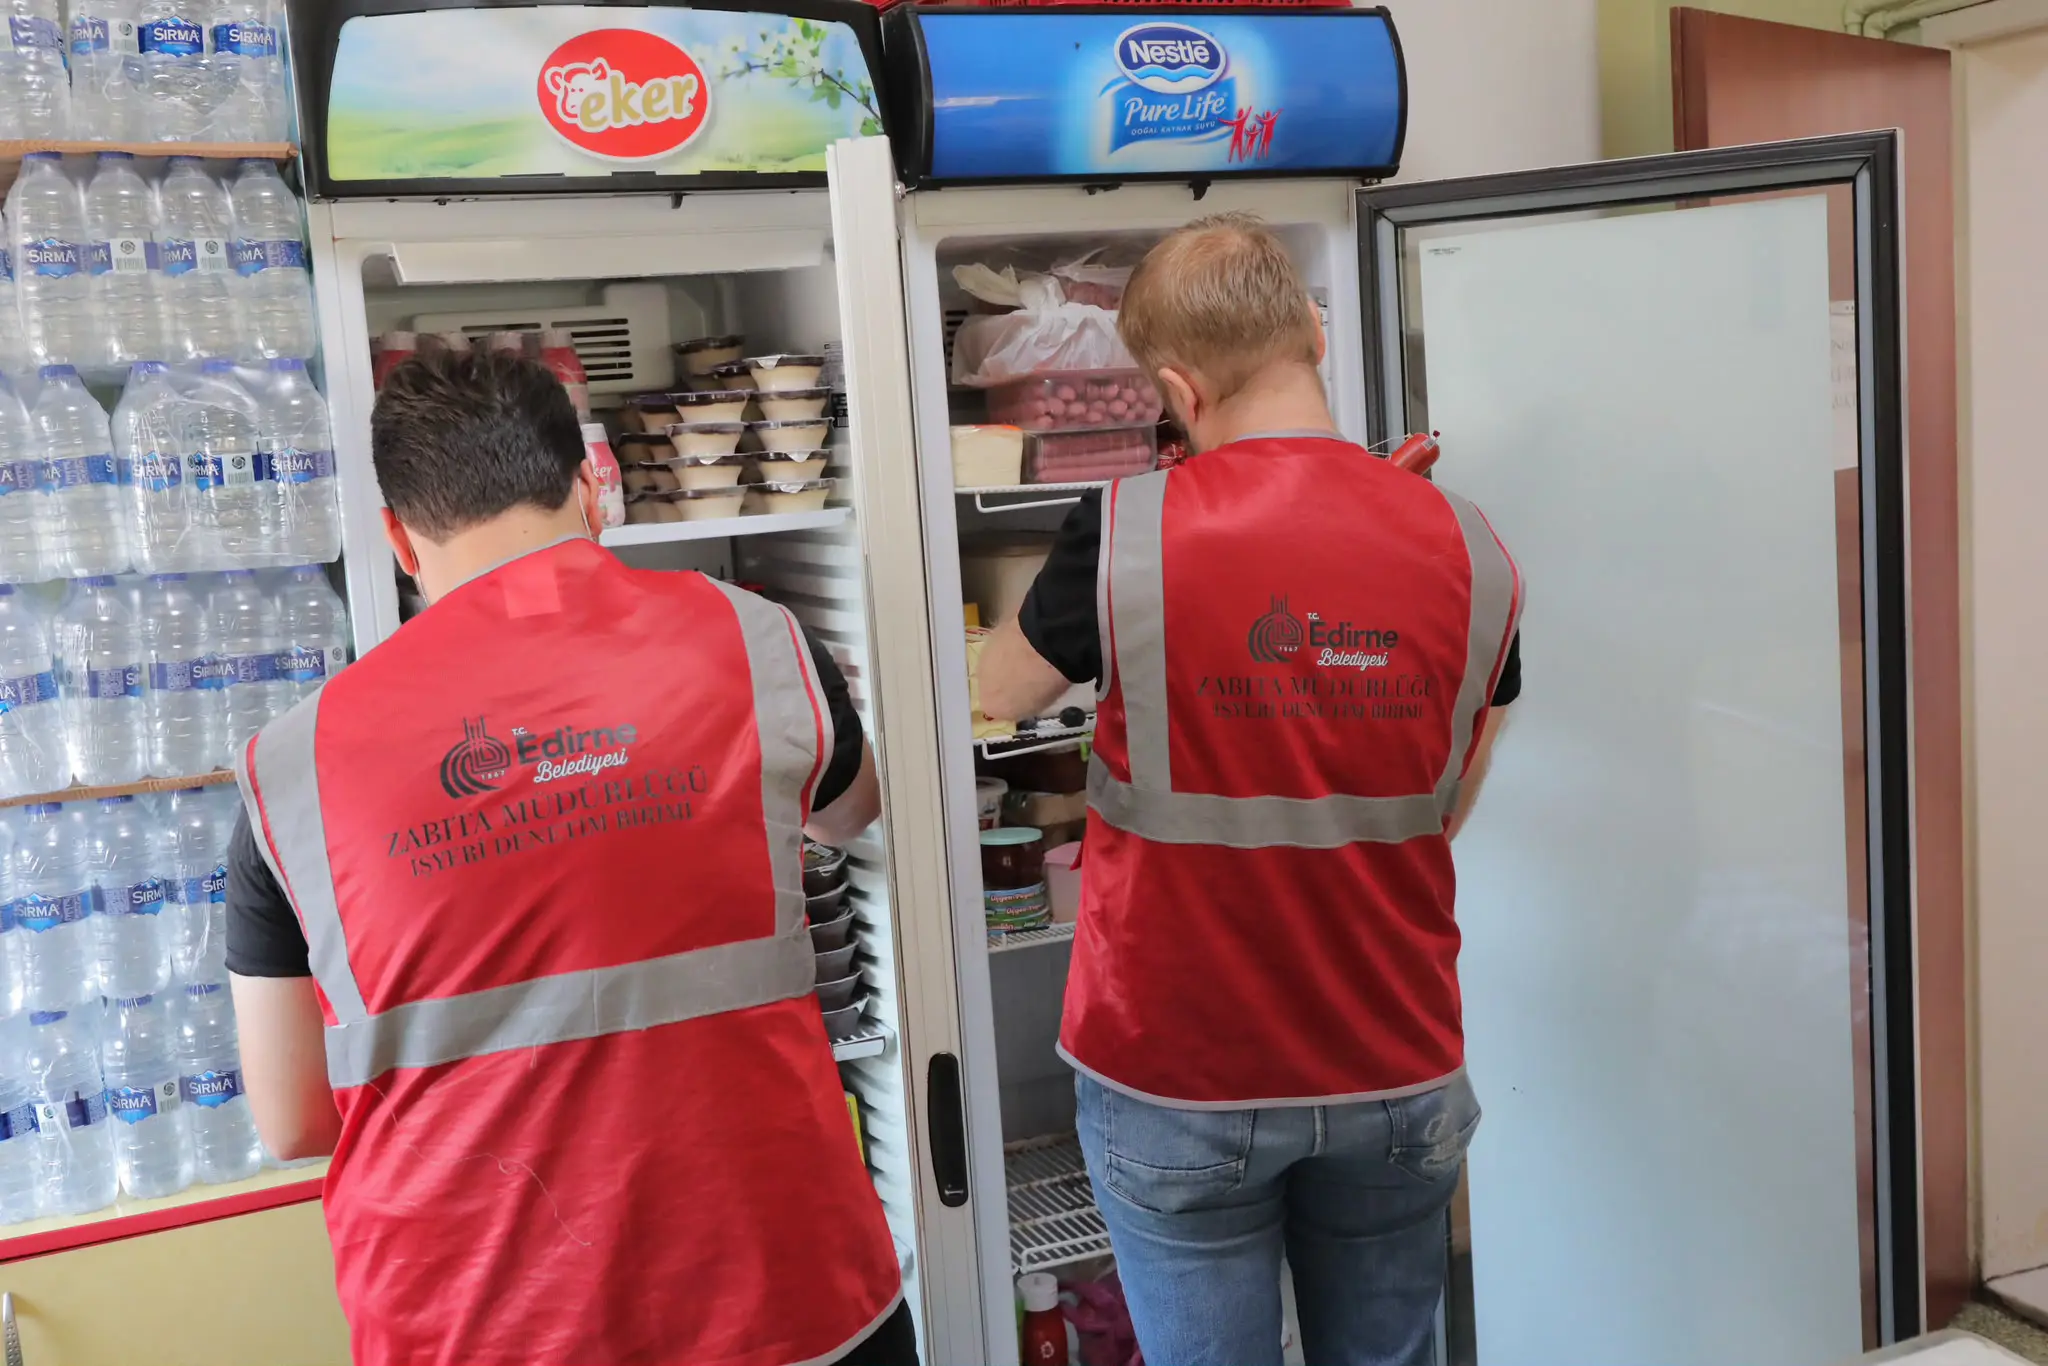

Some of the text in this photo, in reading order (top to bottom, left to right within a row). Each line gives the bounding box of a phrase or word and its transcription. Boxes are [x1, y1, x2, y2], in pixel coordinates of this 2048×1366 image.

[153, 27, 200, 43] SIRMA
[229, 28, 273, 46] SIRMA
[579, 74, 694, 129] eker
[1124, 91, 1227, 126] Pure Life
[1131, 120, 1216, 136] DOĞAL KAYNAK SUYU
[28, 249, 76, 263] SIRMA
[271, 457, 314, 472] SIRMA
[1307, 612, 1319, 621] T.C.
[1309, 621, 1399, 649] Edirne
[1317, 648, 1388, 671] Belediyesi
[511, 727, 528, 736] T.C.
[515, 723, 637, 765] Edirne
[533, 748, 629, 784] Belediyesi
[384, 766, 707, 858] ZABITA MÜDÜRLÜĞÜ
[494, 814, 608, 856] DENETİM
[132, 889, 162, 904] SIRM
[15, 902, 61, 918] SIRMA
[189, 1078, 233, 1096] SIRMA
[112, 1094, 152, 1110] SIRMA
